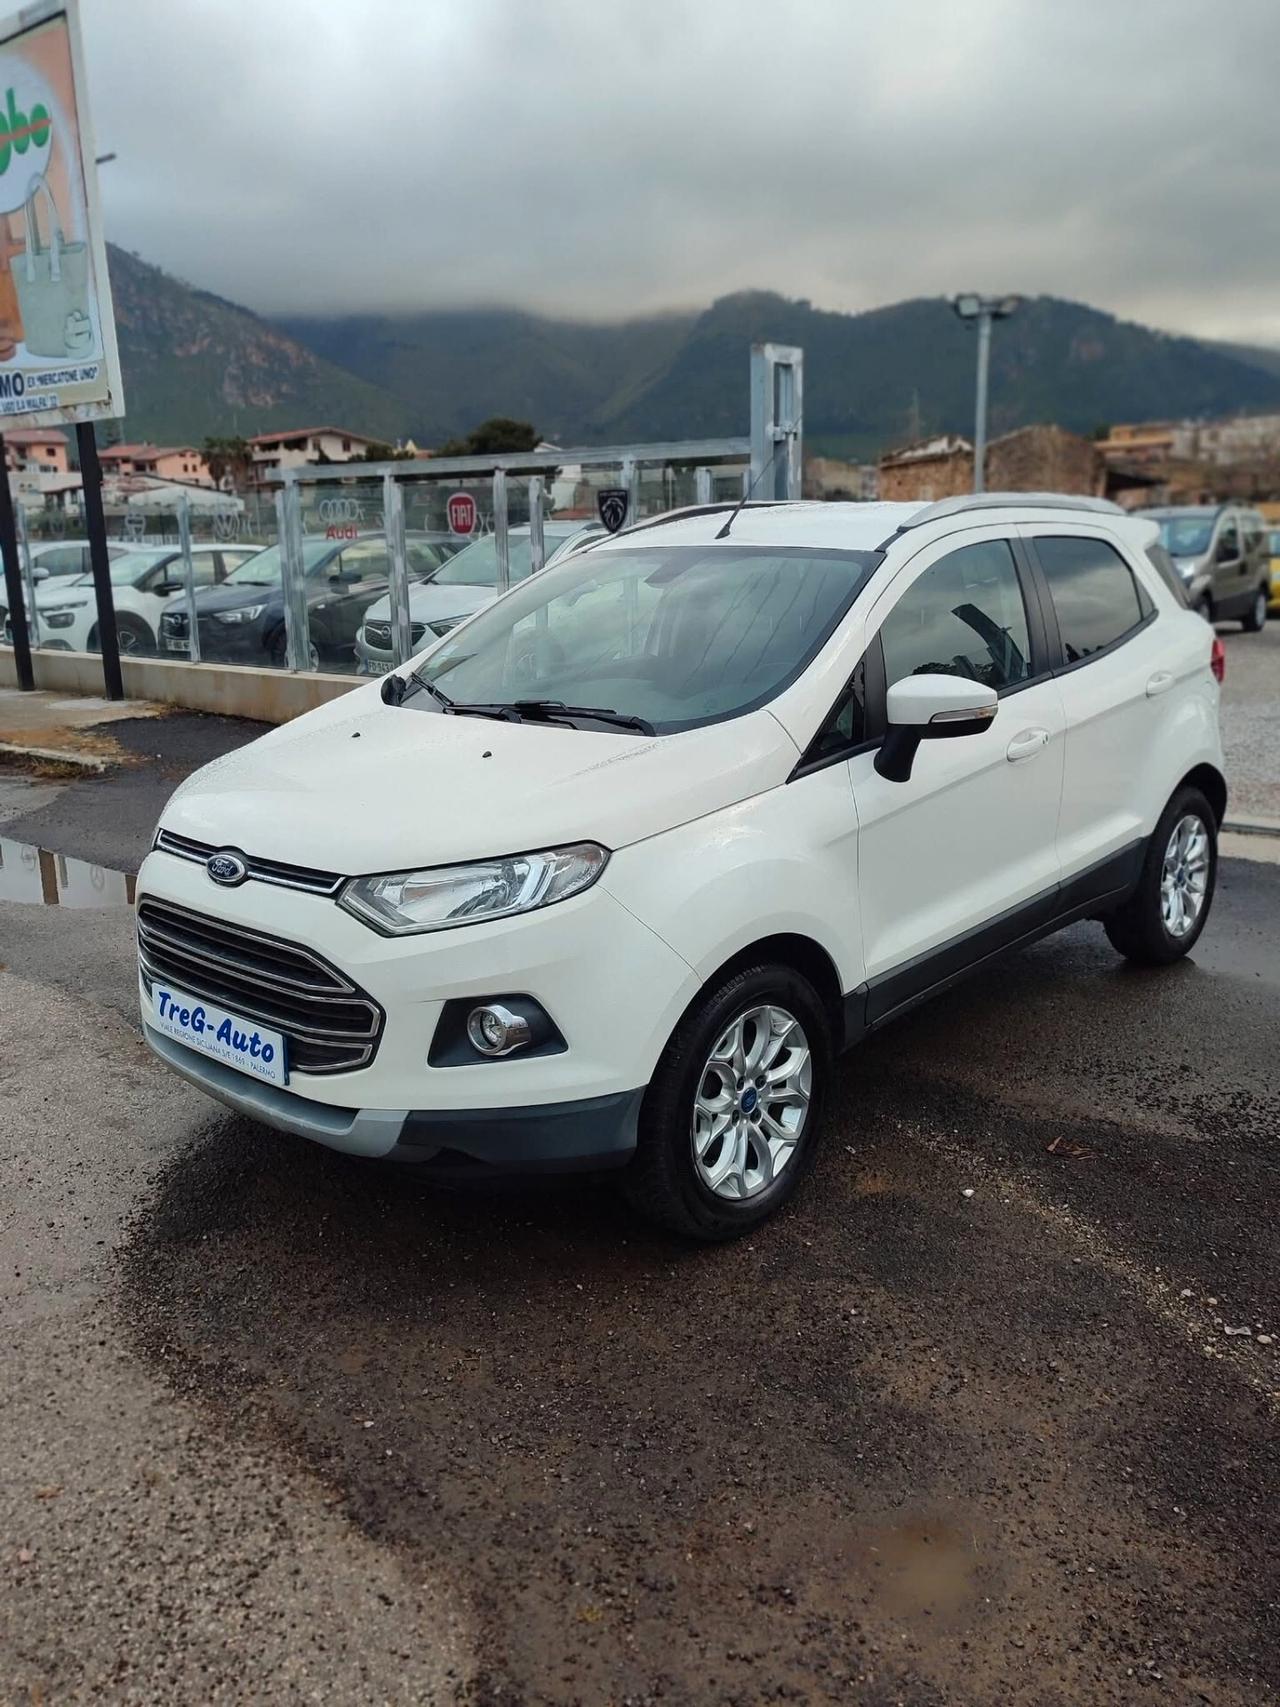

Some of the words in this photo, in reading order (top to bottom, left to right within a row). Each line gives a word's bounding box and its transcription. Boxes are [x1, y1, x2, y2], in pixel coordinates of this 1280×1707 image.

[451, 504, 472, 527] FIAT
[326, 523, 358, 540] Audi
[158, 991, 275, 1063] TreG-Auto
[250, 1061, 276, 1080] PALERMO
